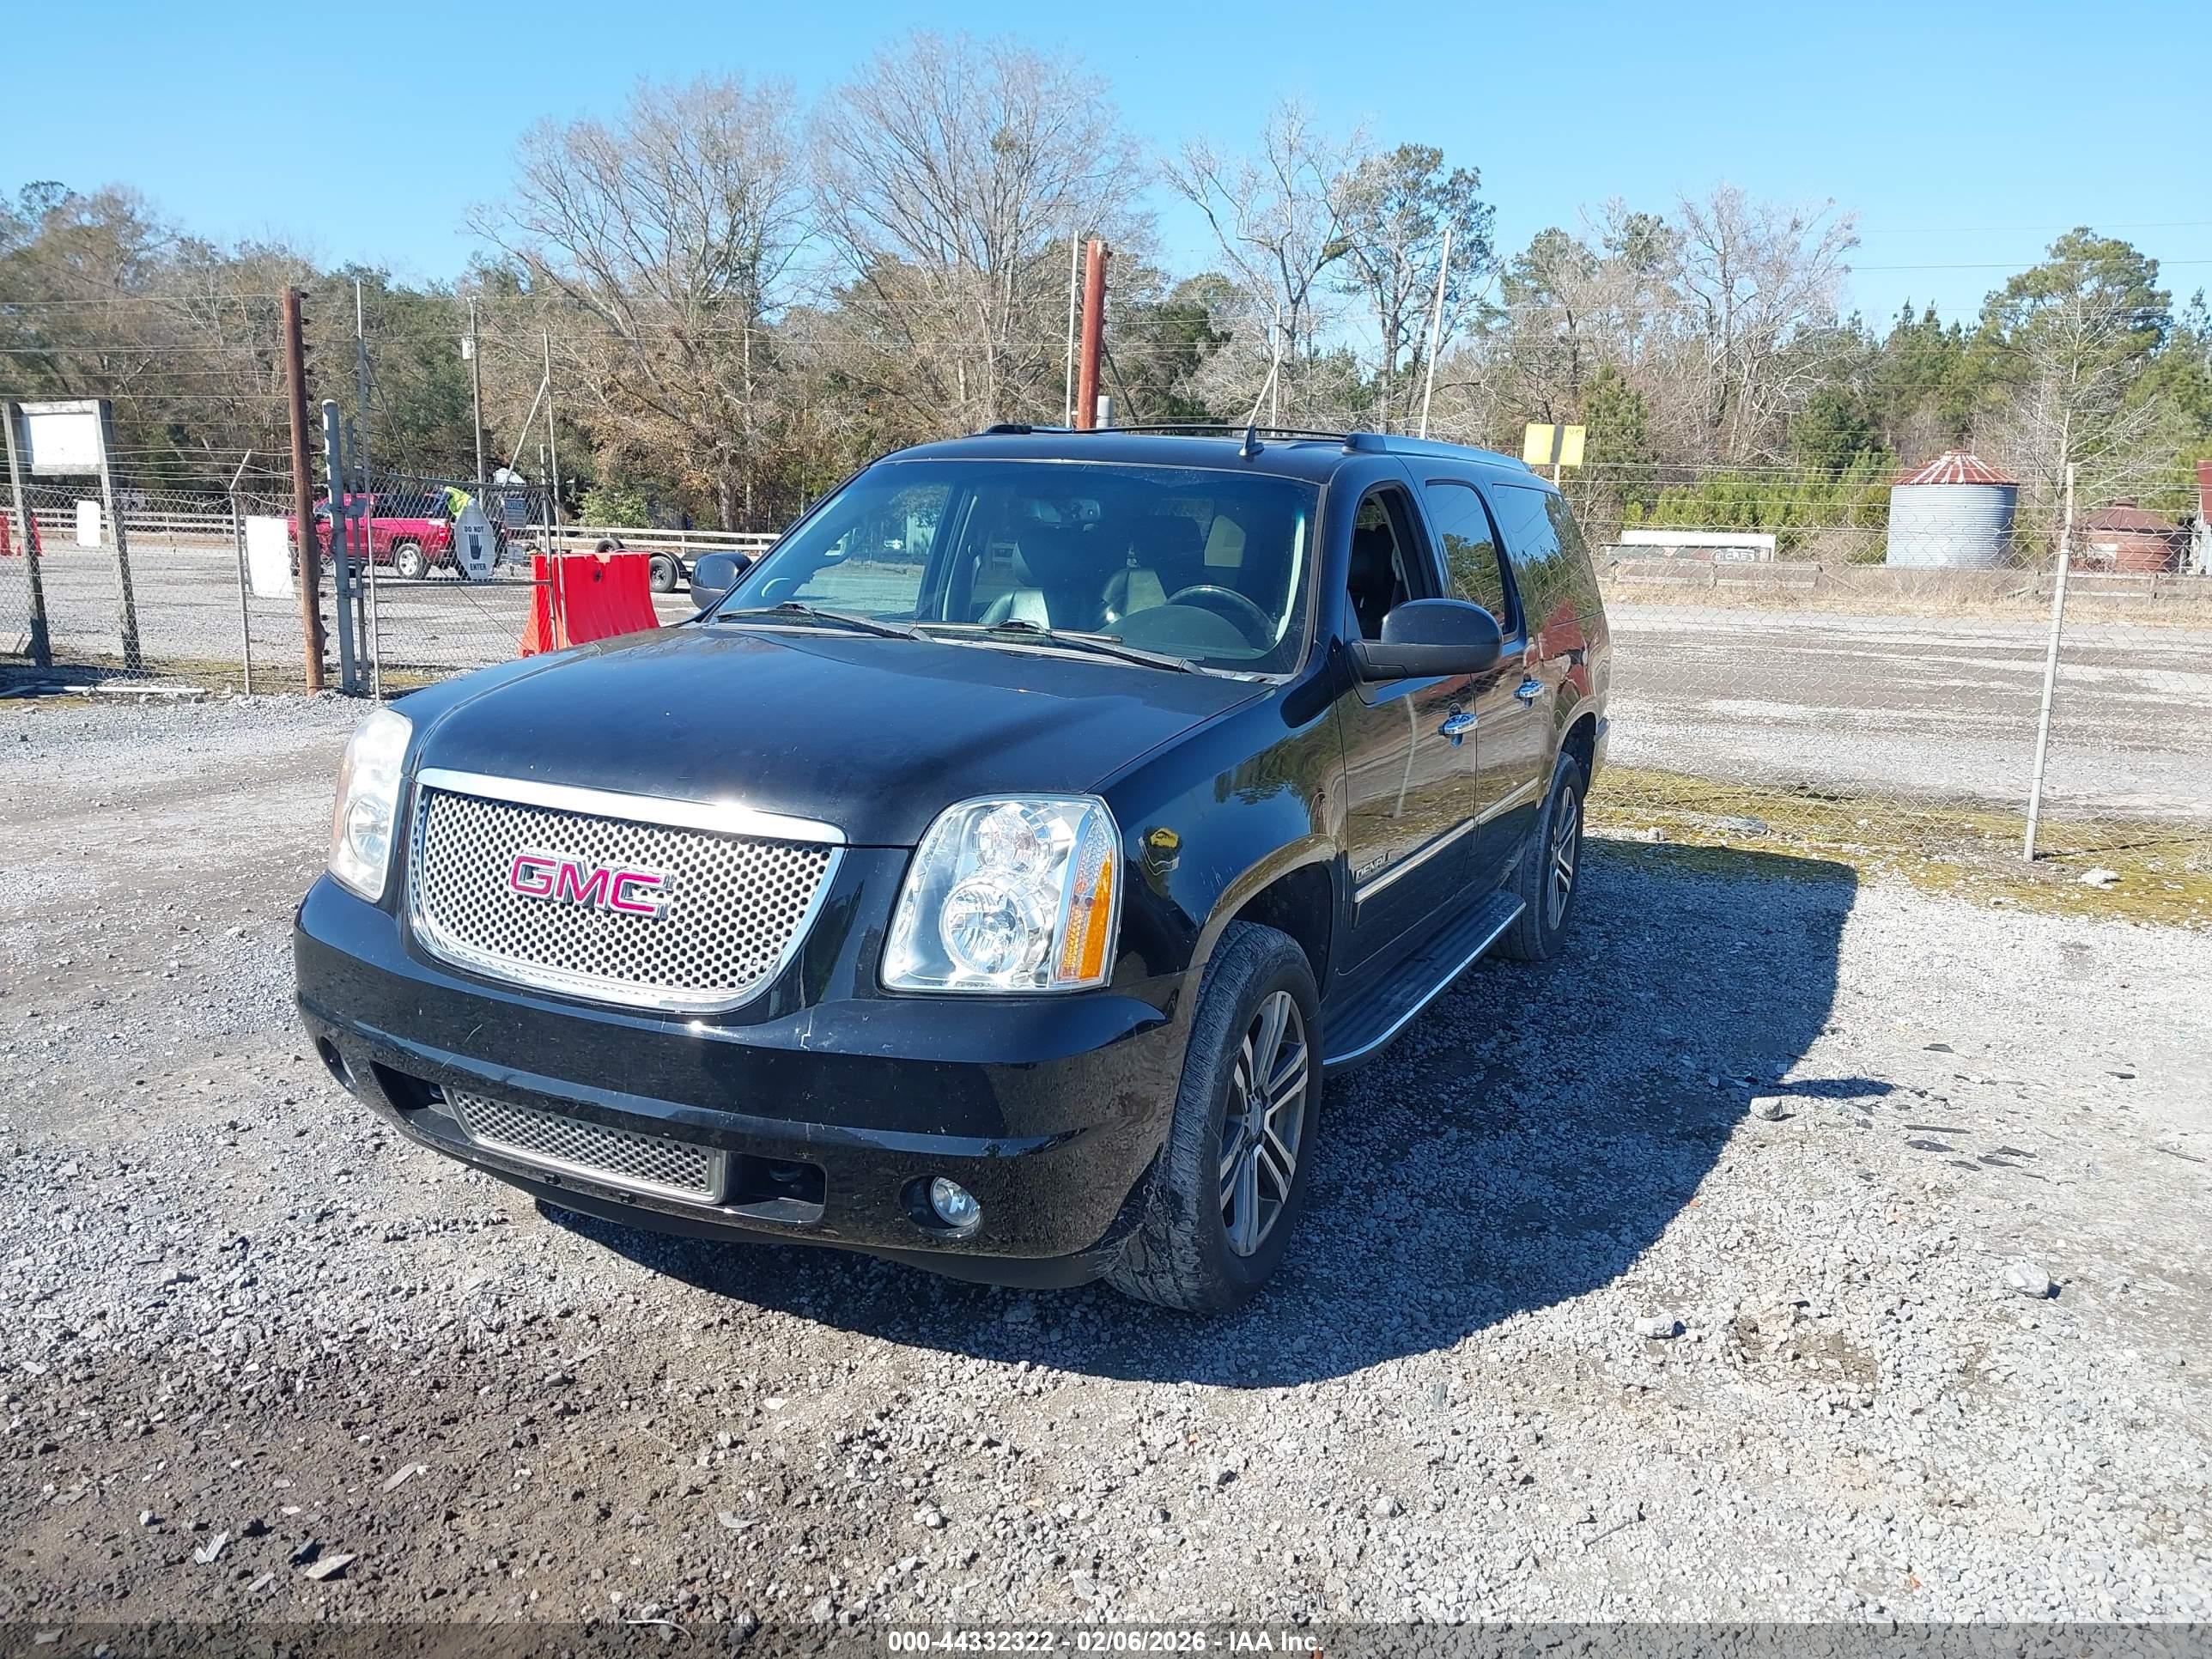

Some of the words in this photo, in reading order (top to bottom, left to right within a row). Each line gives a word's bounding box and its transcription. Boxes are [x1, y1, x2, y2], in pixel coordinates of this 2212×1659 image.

[469, 562, 487, 571] ENTER
[1354, 851, 1391, 881] DENALI
[510, 854, 673, 920] GMC
